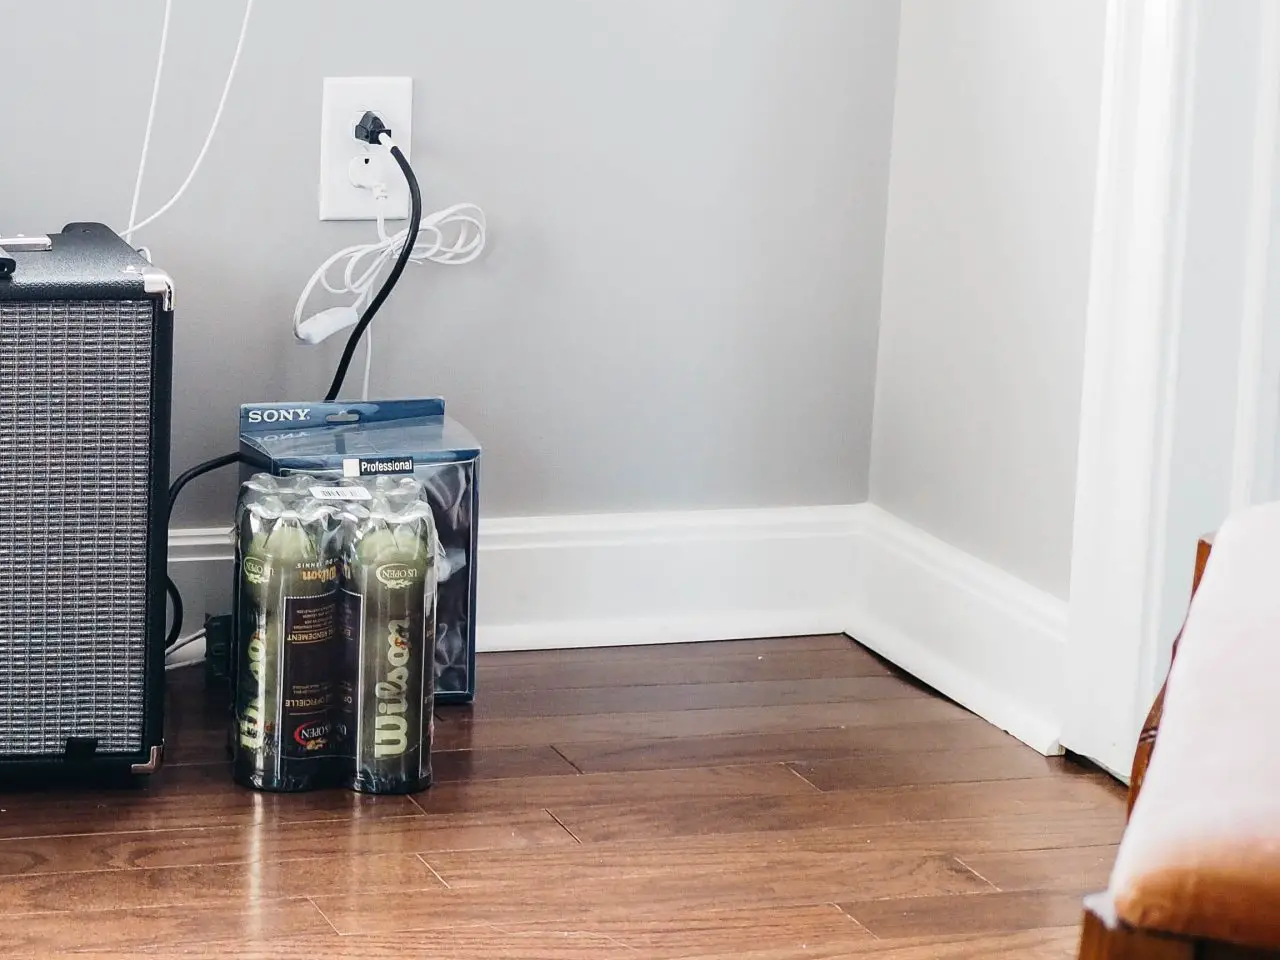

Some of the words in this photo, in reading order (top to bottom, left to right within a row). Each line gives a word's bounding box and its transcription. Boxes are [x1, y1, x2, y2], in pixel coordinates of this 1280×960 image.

[248, 407, 311, 424] SONY
[361, 459, 413, 473] Professional
[381, 565, 407, 580] OPEN
[405, 566, 418, 578] US
